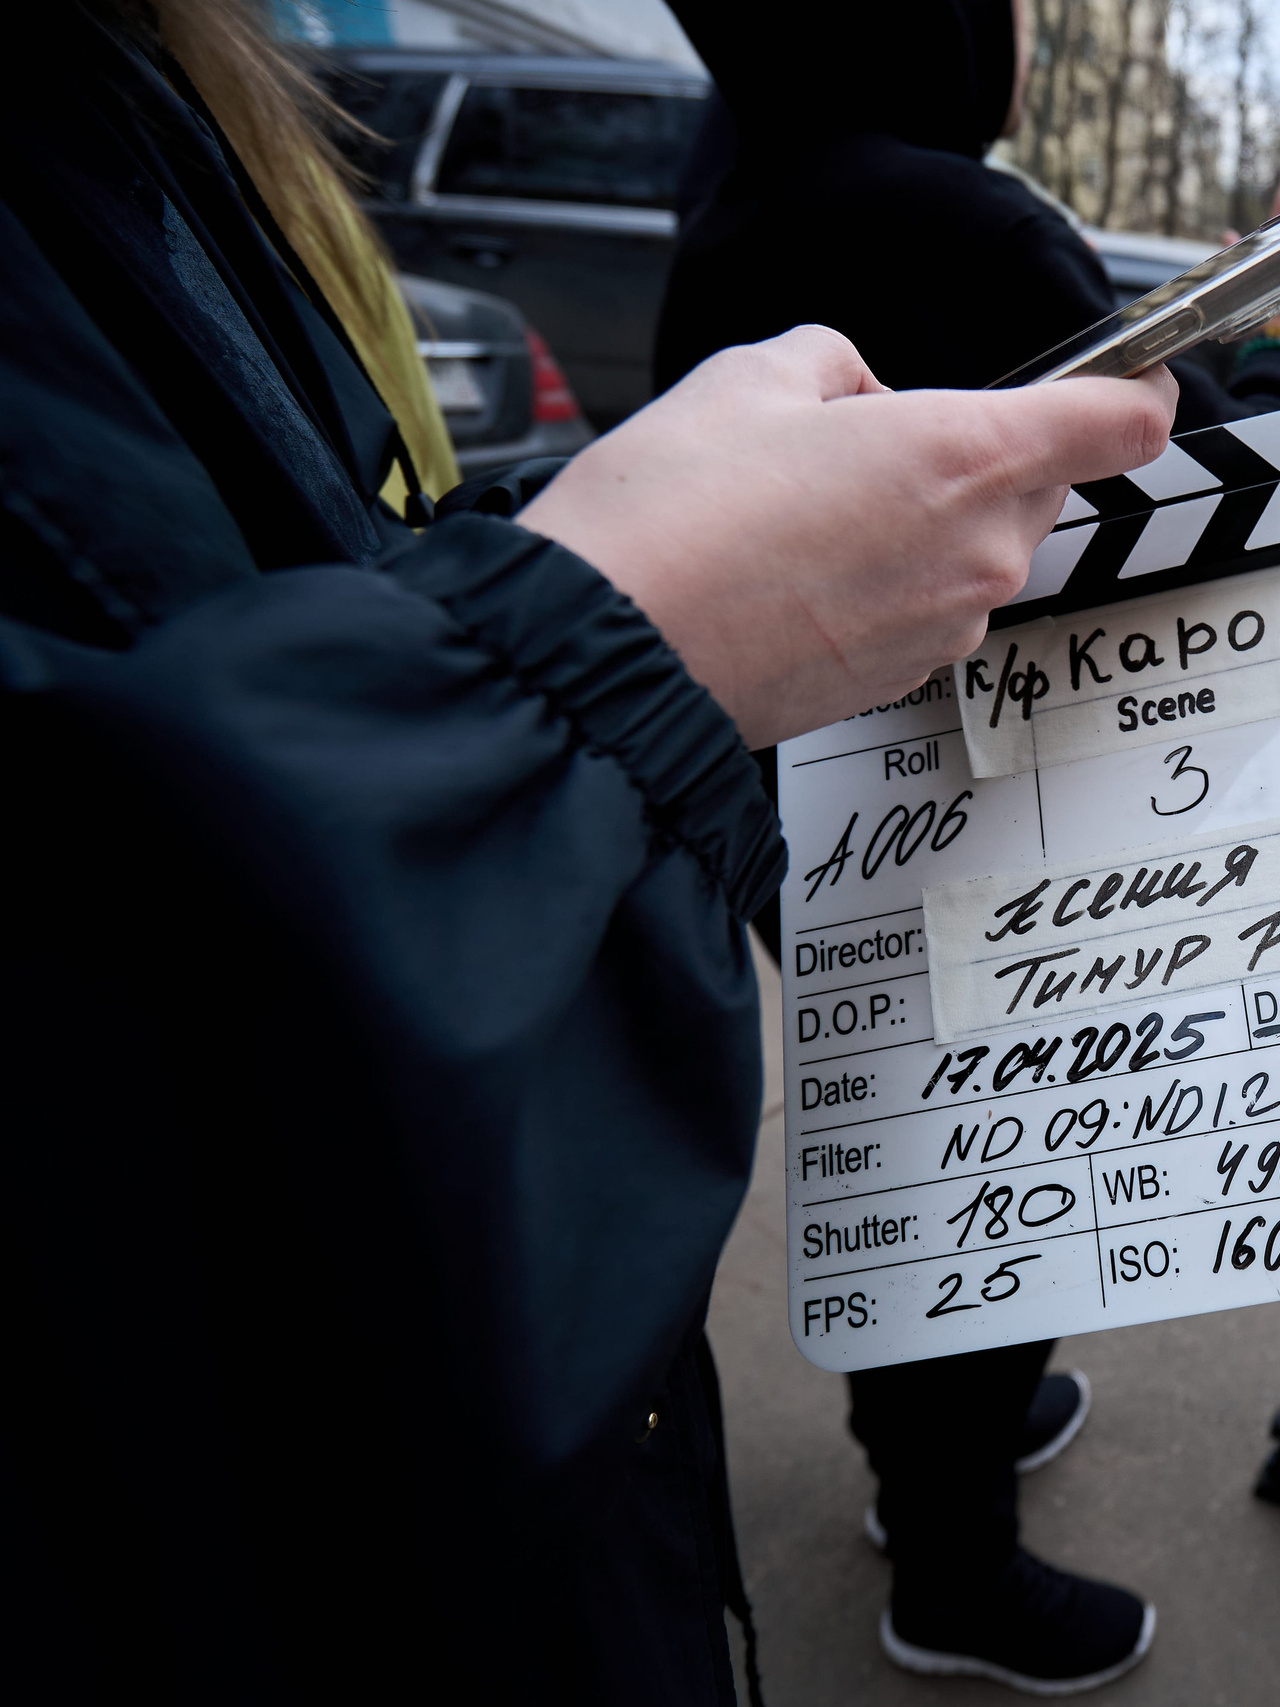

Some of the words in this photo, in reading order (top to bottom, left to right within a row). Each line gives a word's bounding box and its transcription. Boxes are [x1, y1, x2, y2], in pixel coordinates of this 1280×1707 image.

[1118, 687, 1216, 733] Scene
[884, 740, 940, 781] Roll
[1150, 745, 1210, 816] 3
[795, 928, 924, 978] Director:
[797, 992, 907, 1044] D.O.P.:
[921, 1010, 1226, 1100] 17.04.2025
[801, 1074, 877, 1112] Date:
[801, 1141, 882, 1182] Filter:
[1102, 1164, 1170, 1206] WB:
[802, 1211, 919, 1259] Shutter:
[946, 1180, 1076, 1249] 180
[926, 1254, 1042, 1319] 25
[1110, 1242, 1181, 1284] ISO:
[803, 1293, 878, 1338] FPS:
